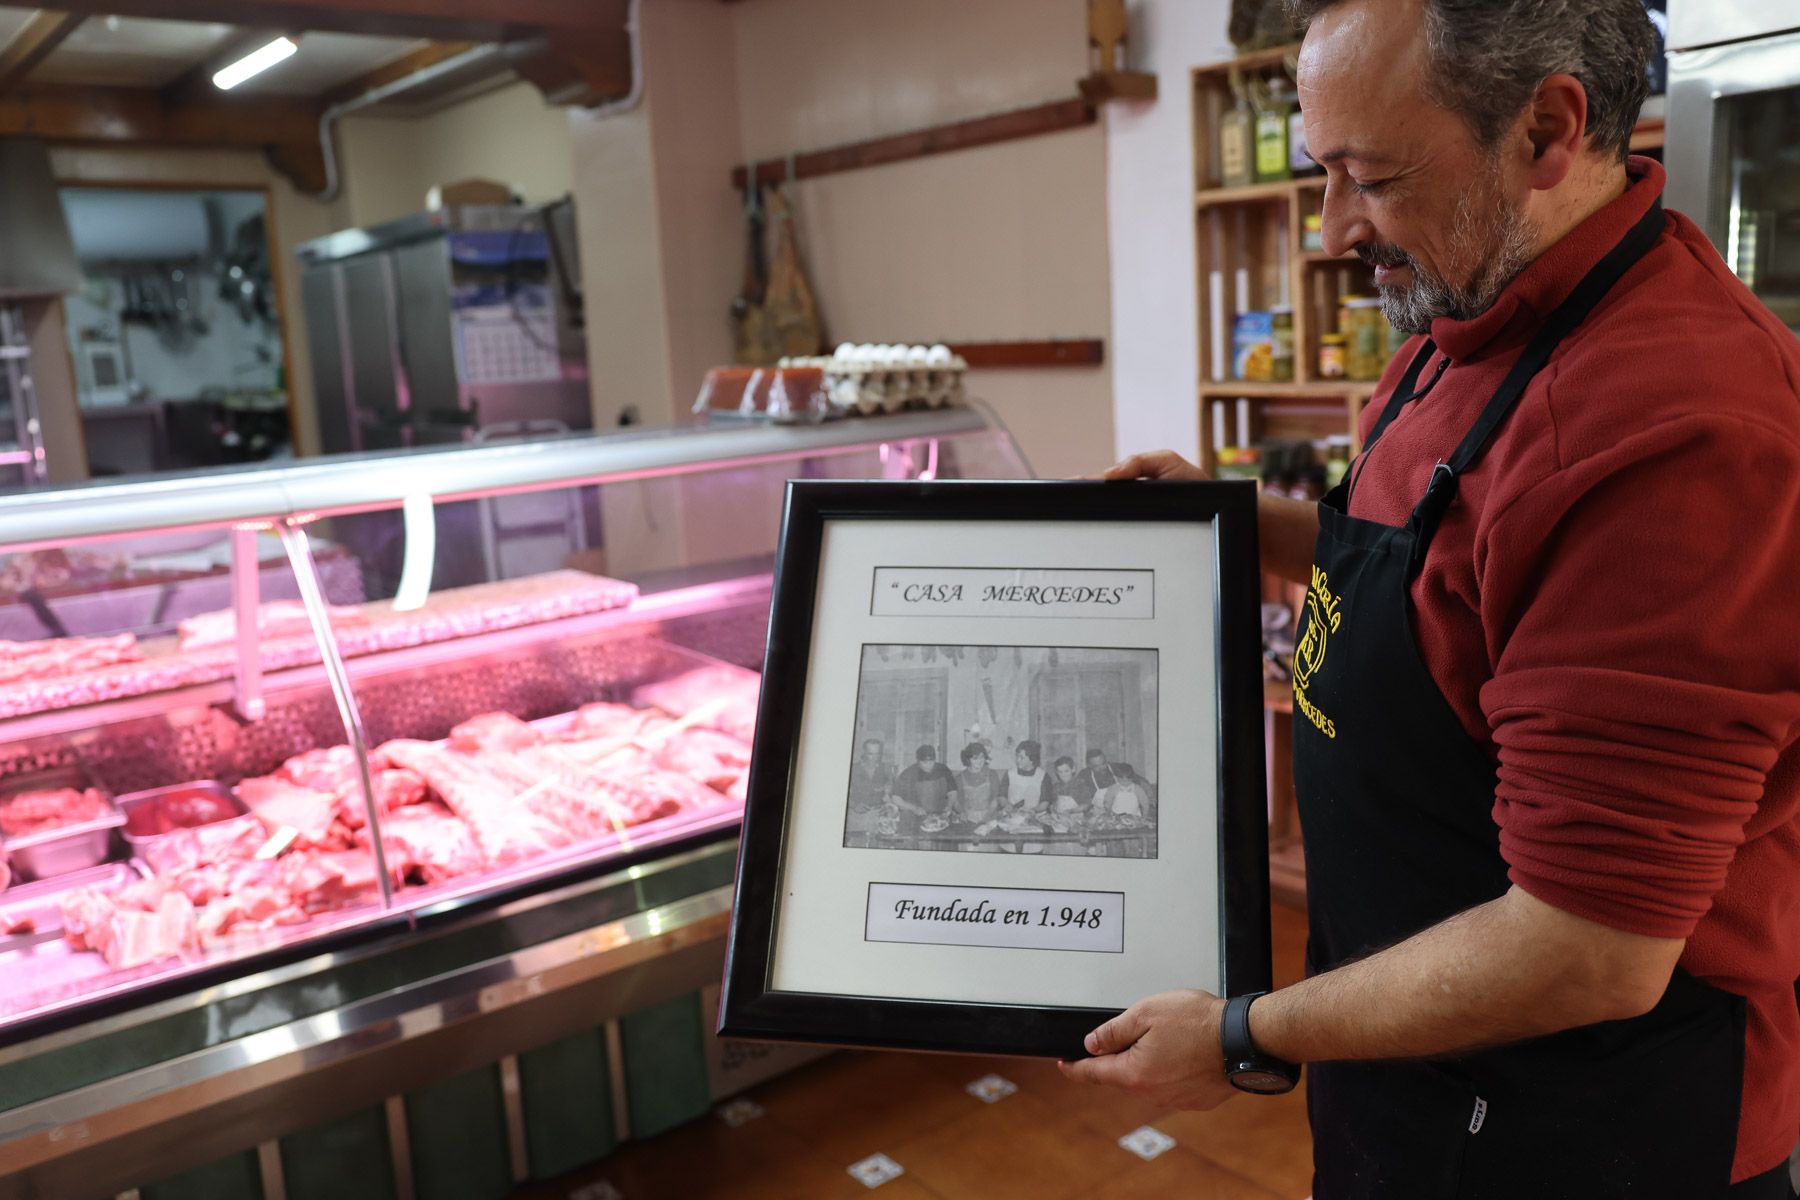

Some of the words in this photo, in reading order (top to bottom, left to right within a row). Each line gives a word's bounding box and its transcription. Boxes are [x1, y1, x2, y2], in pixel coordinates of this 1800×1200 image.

[982, 584, 1135, 606] MERCEDES”
[894, 898, 997, 924] Fundada
[1003, 908, 1030, 926] en
[1037, 905, 1103, 930] 1.948
